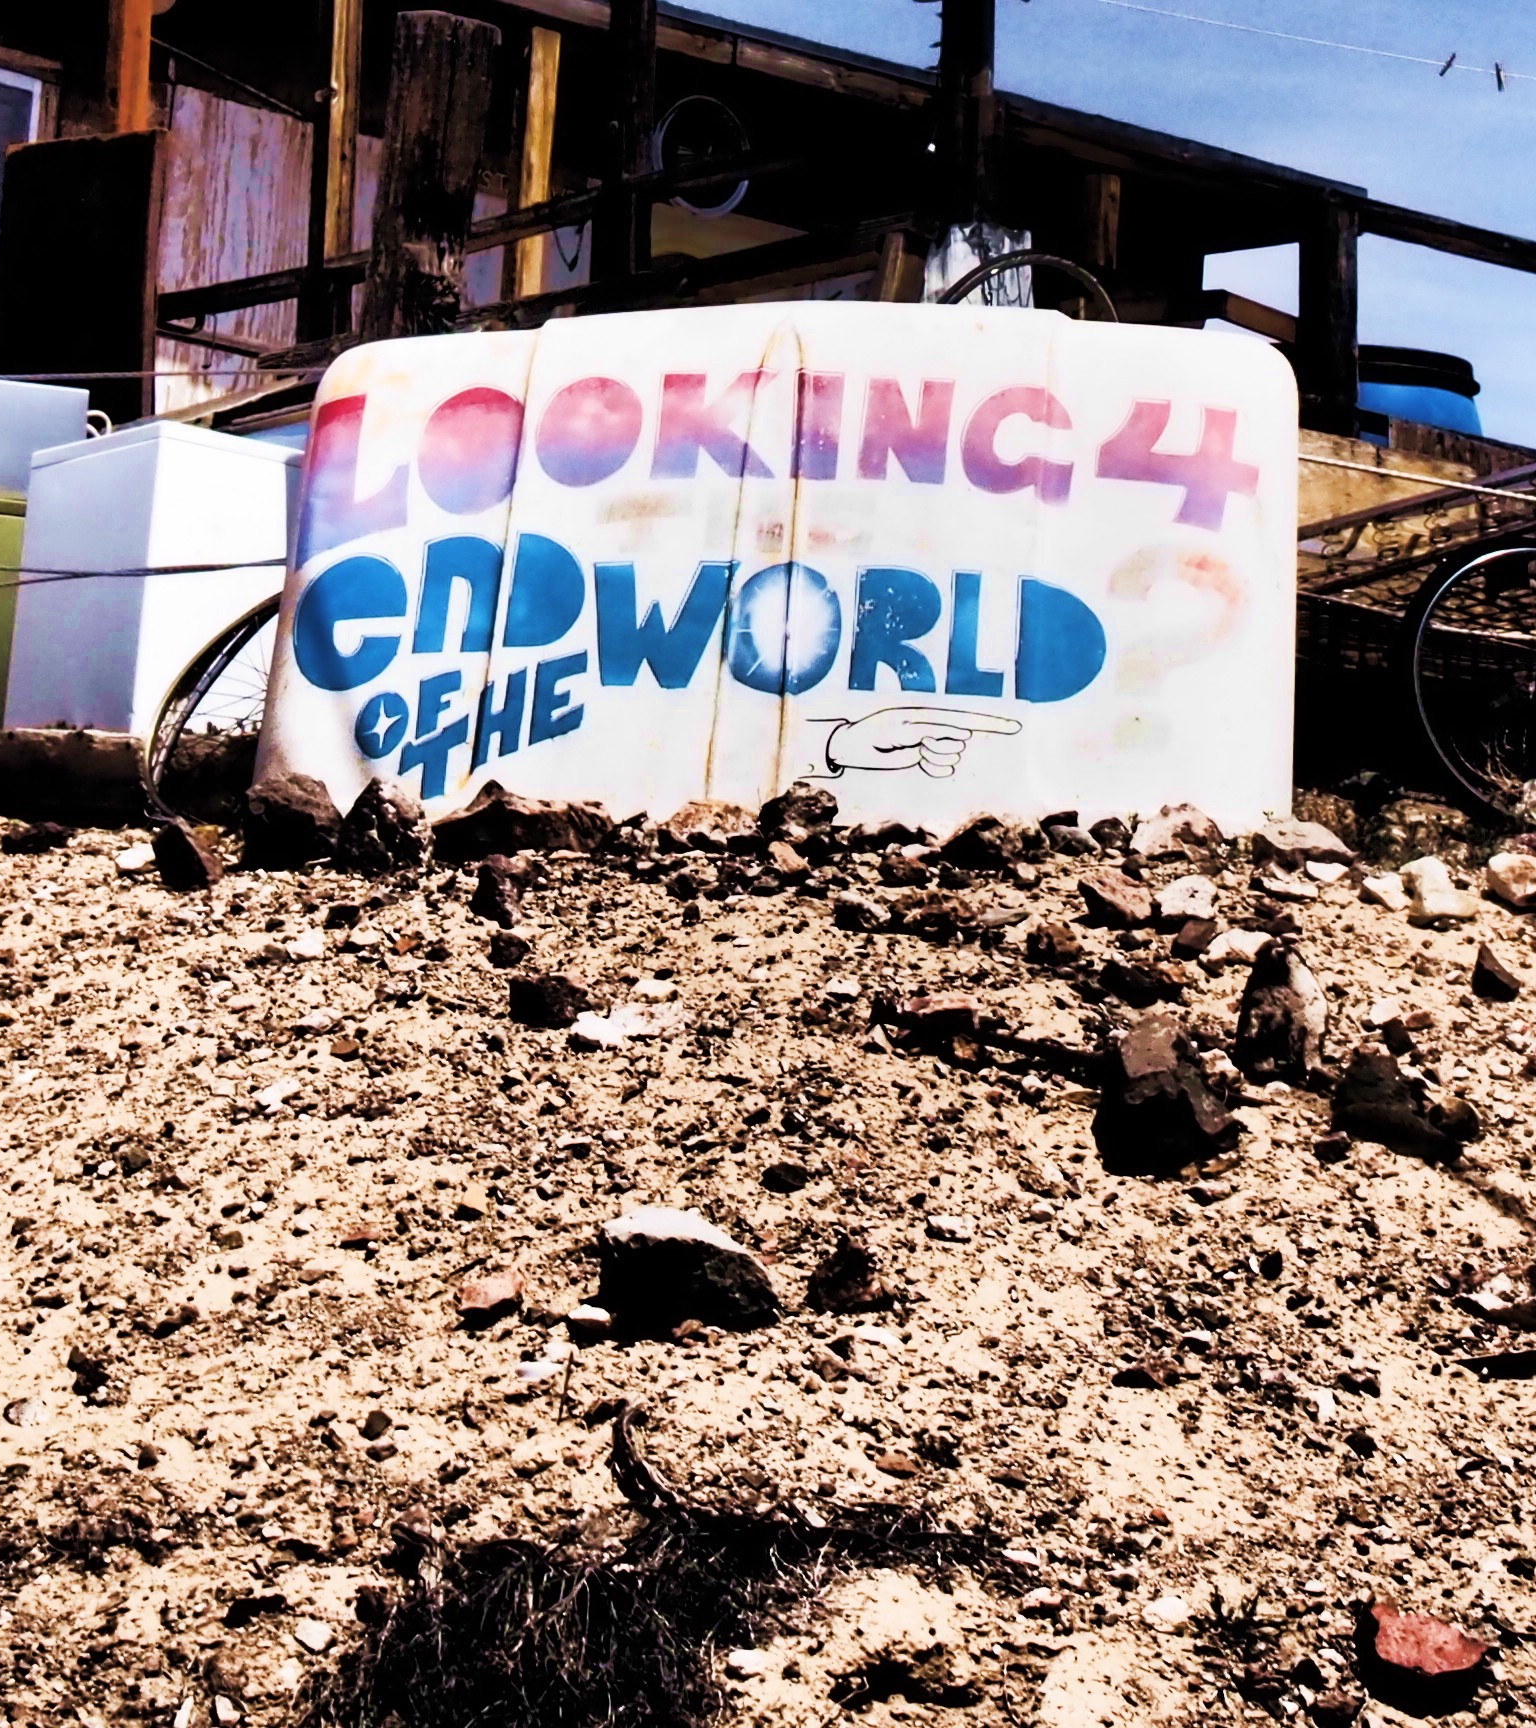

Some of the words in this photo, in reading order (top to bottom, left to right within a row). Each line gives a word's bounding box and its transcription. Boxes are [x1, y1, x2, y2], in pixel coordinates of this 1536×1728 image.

[296, 366, 1075, 569] LOOKING
[1095, 398, 1260, 533] 4
[594, 559, 1107, 705] WORLD
[354, 669, 462, 760] OF
[397, 648, 589, 801] THE
